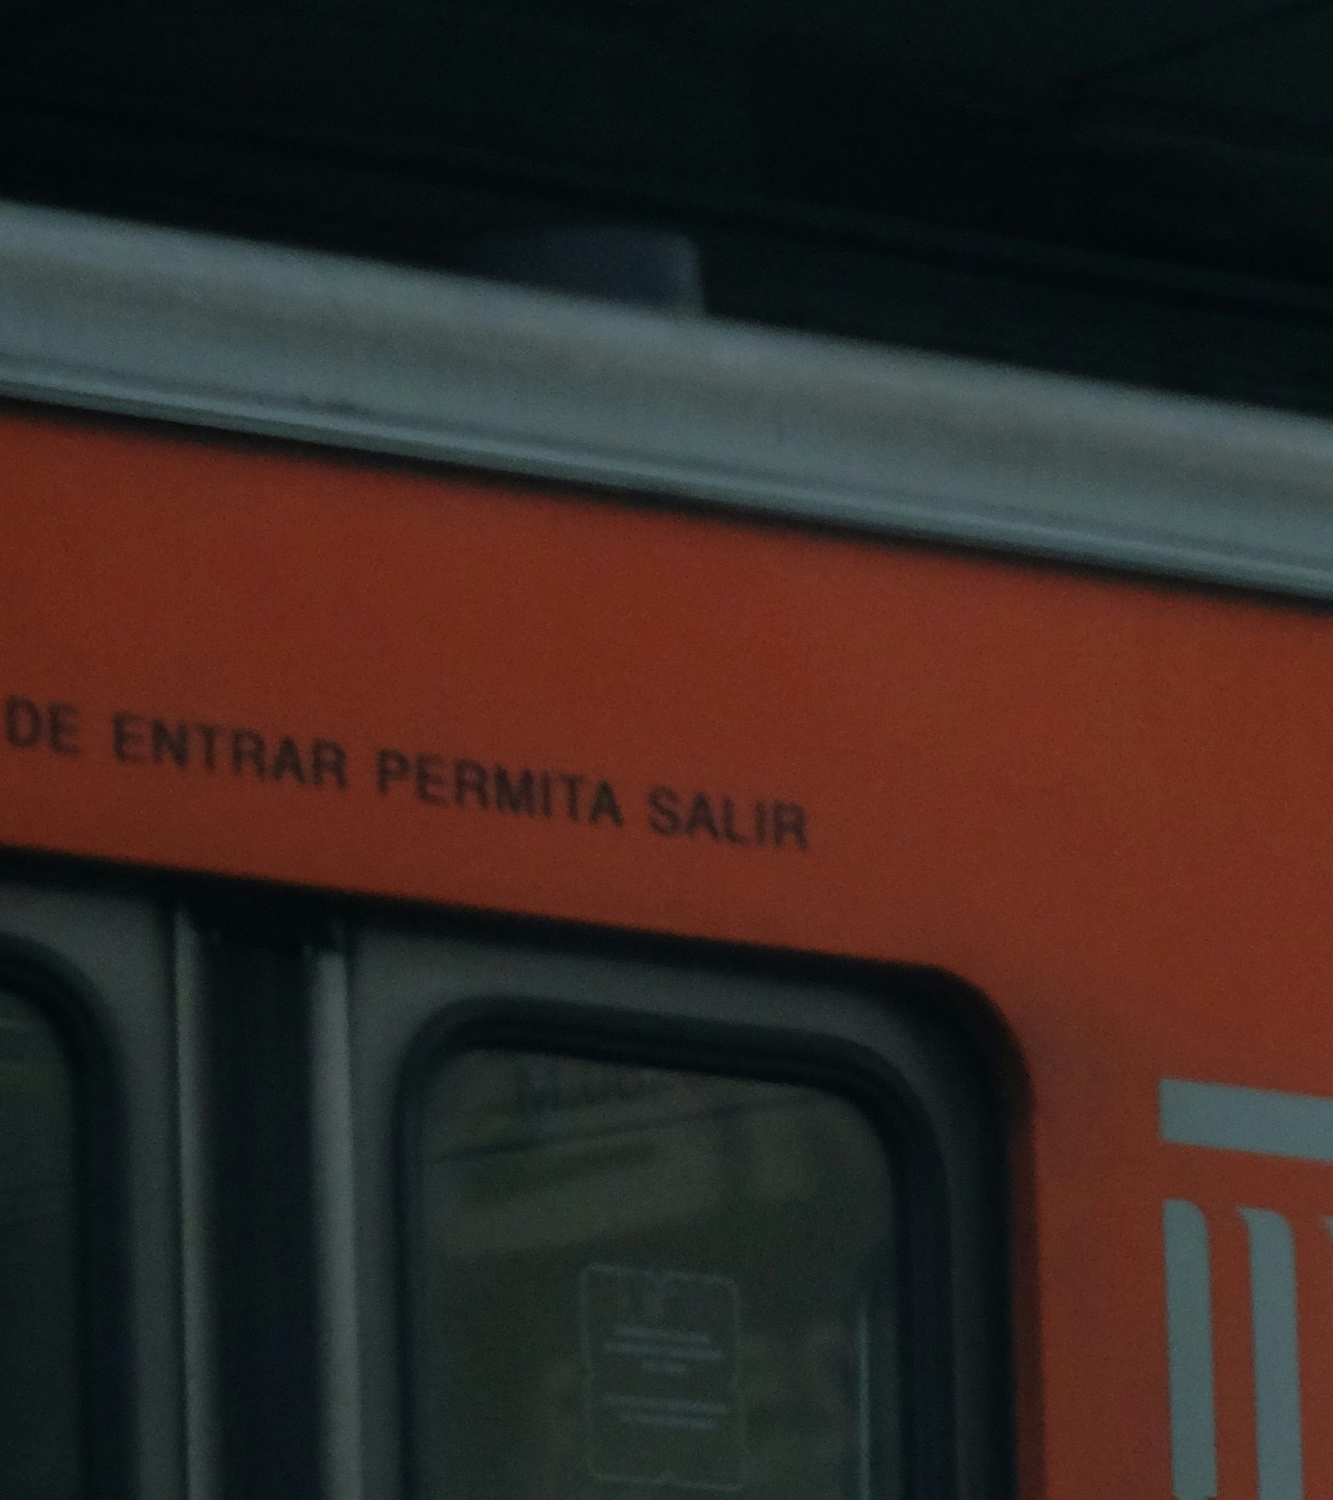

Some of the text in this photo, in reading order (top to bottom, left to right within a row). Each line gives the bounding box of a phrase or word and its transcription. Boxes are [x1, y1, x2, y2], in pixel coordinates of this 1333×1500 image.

[4, 695, 809, 851] DE ENTRAR PERMITA SALIR
